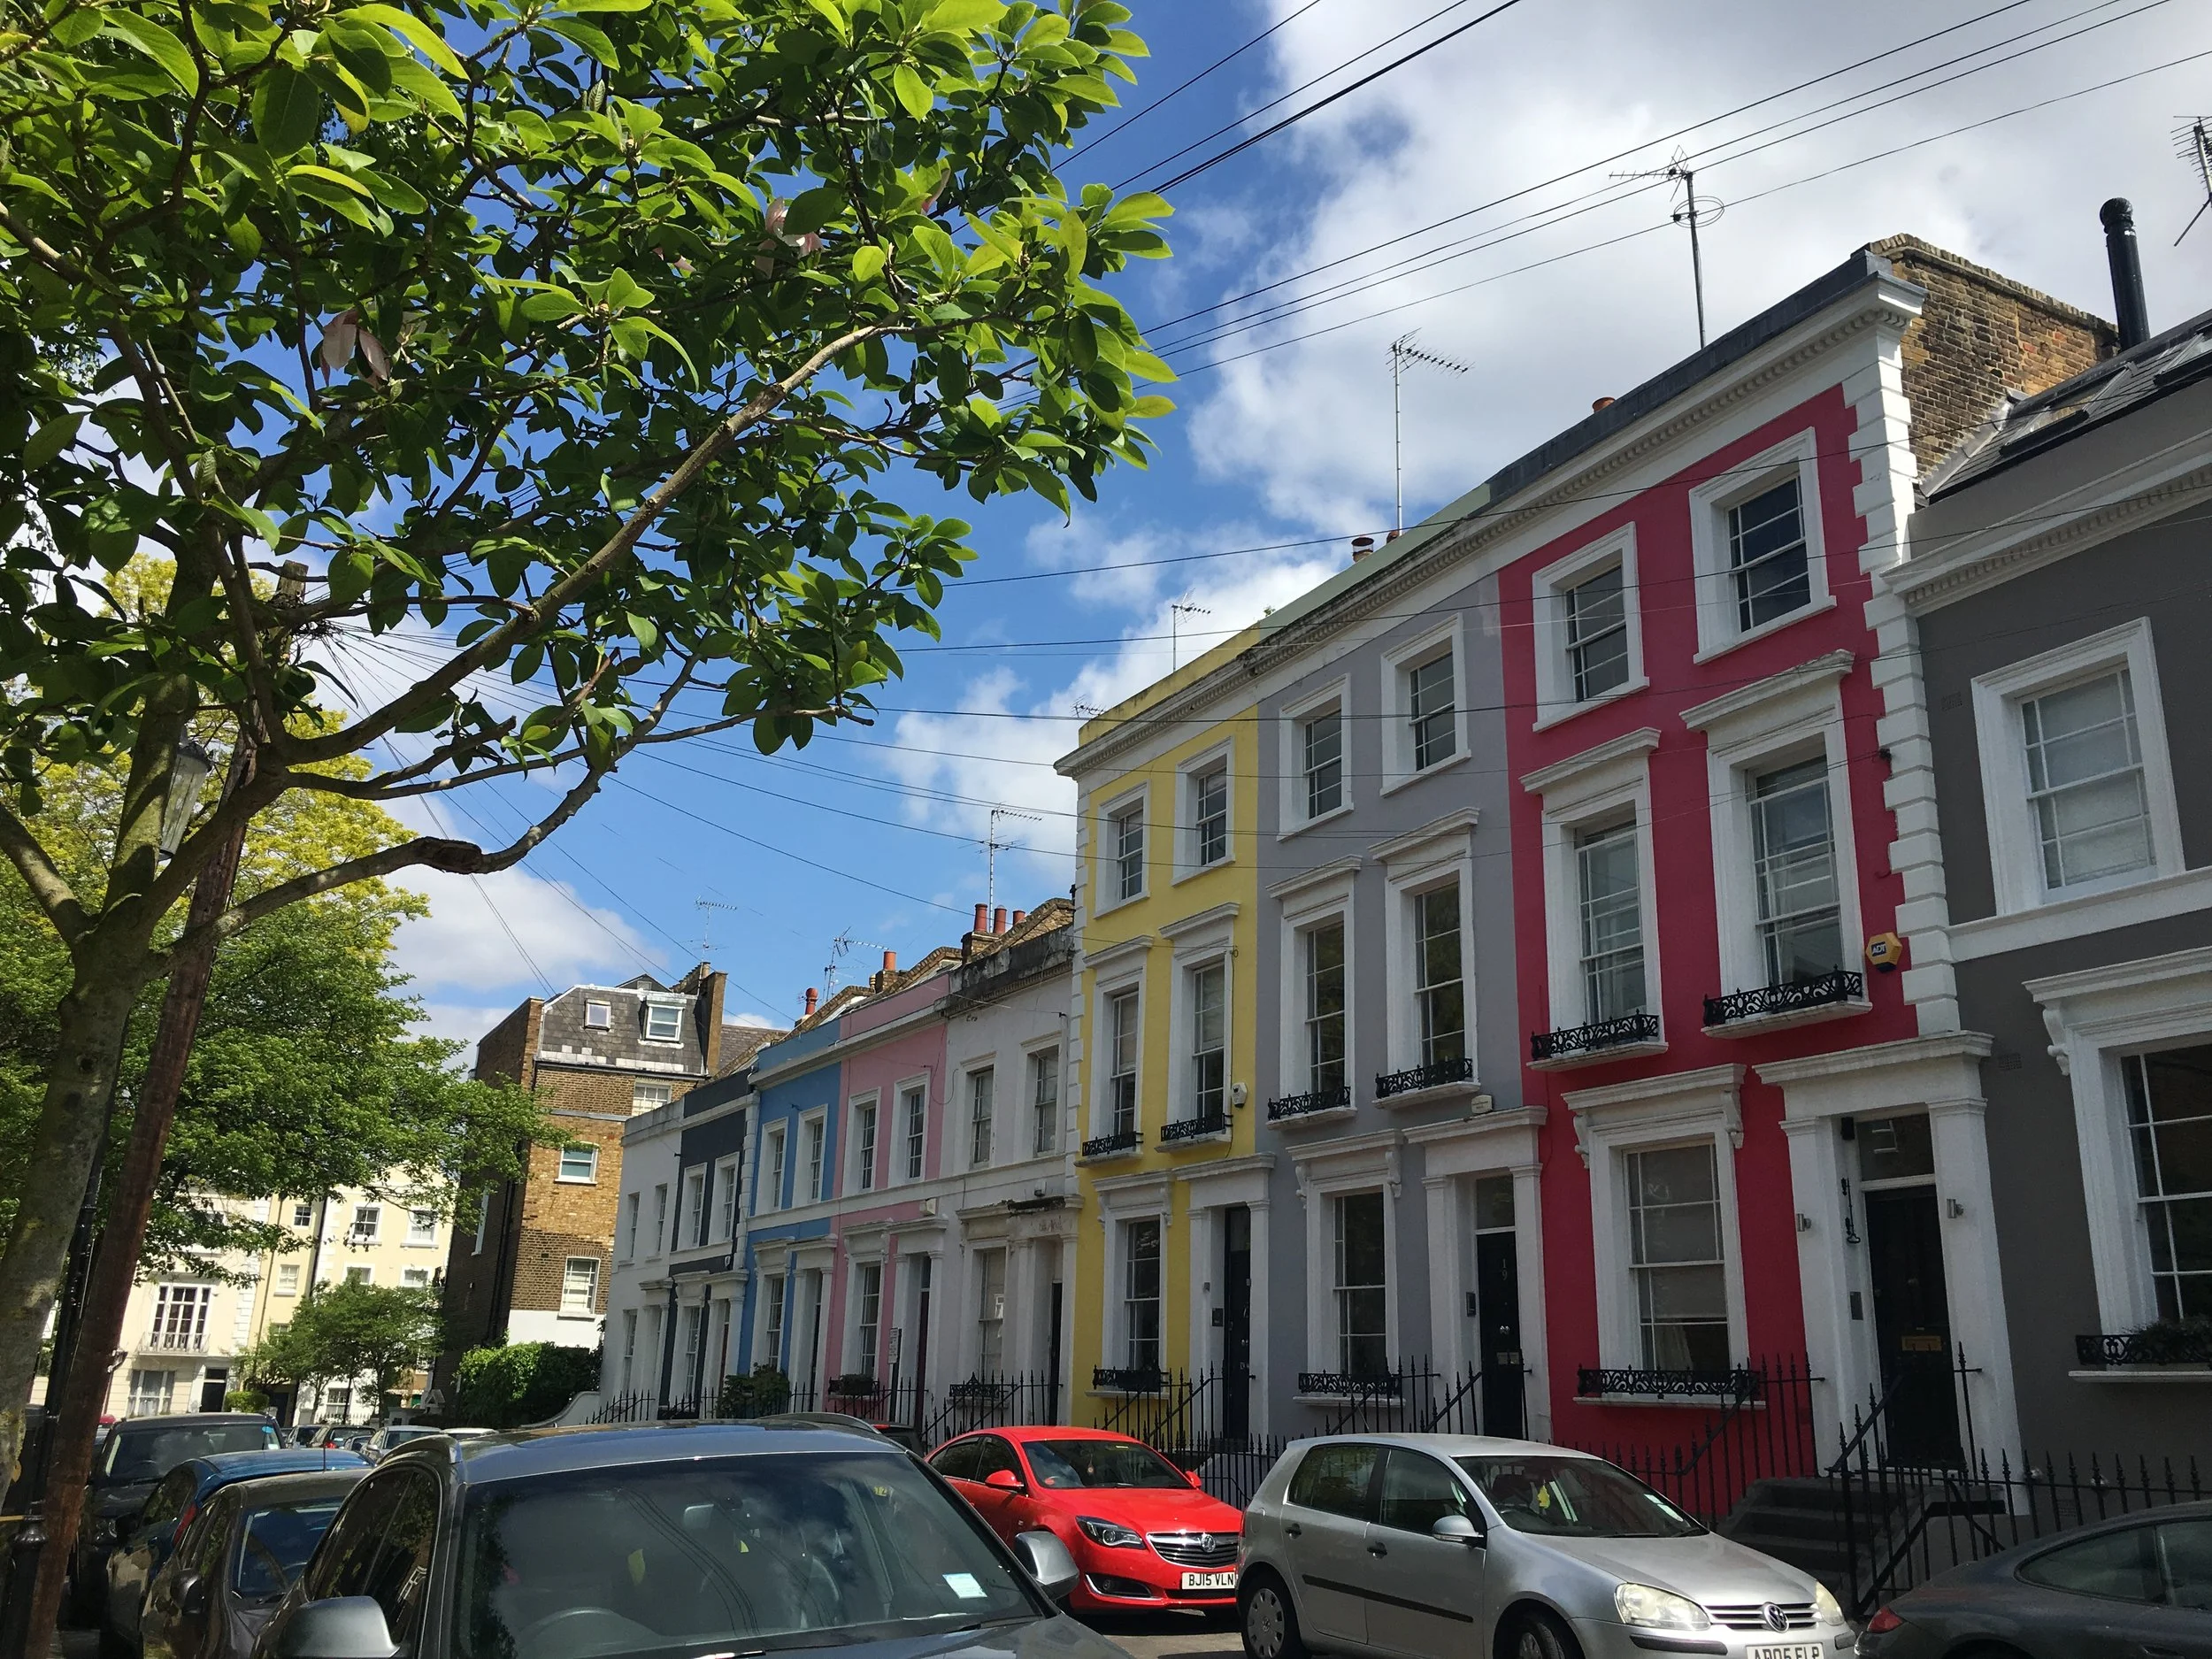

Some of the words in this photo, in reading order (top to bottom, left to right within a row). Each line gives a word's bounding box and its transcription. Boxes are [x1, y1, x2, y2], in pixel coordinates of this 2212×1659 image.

[1871, 943, 1886, 955] ADT
[1188, 1573, 1212, 1586] BJ15
[1215, 1573, 1234, 1586] VLN
